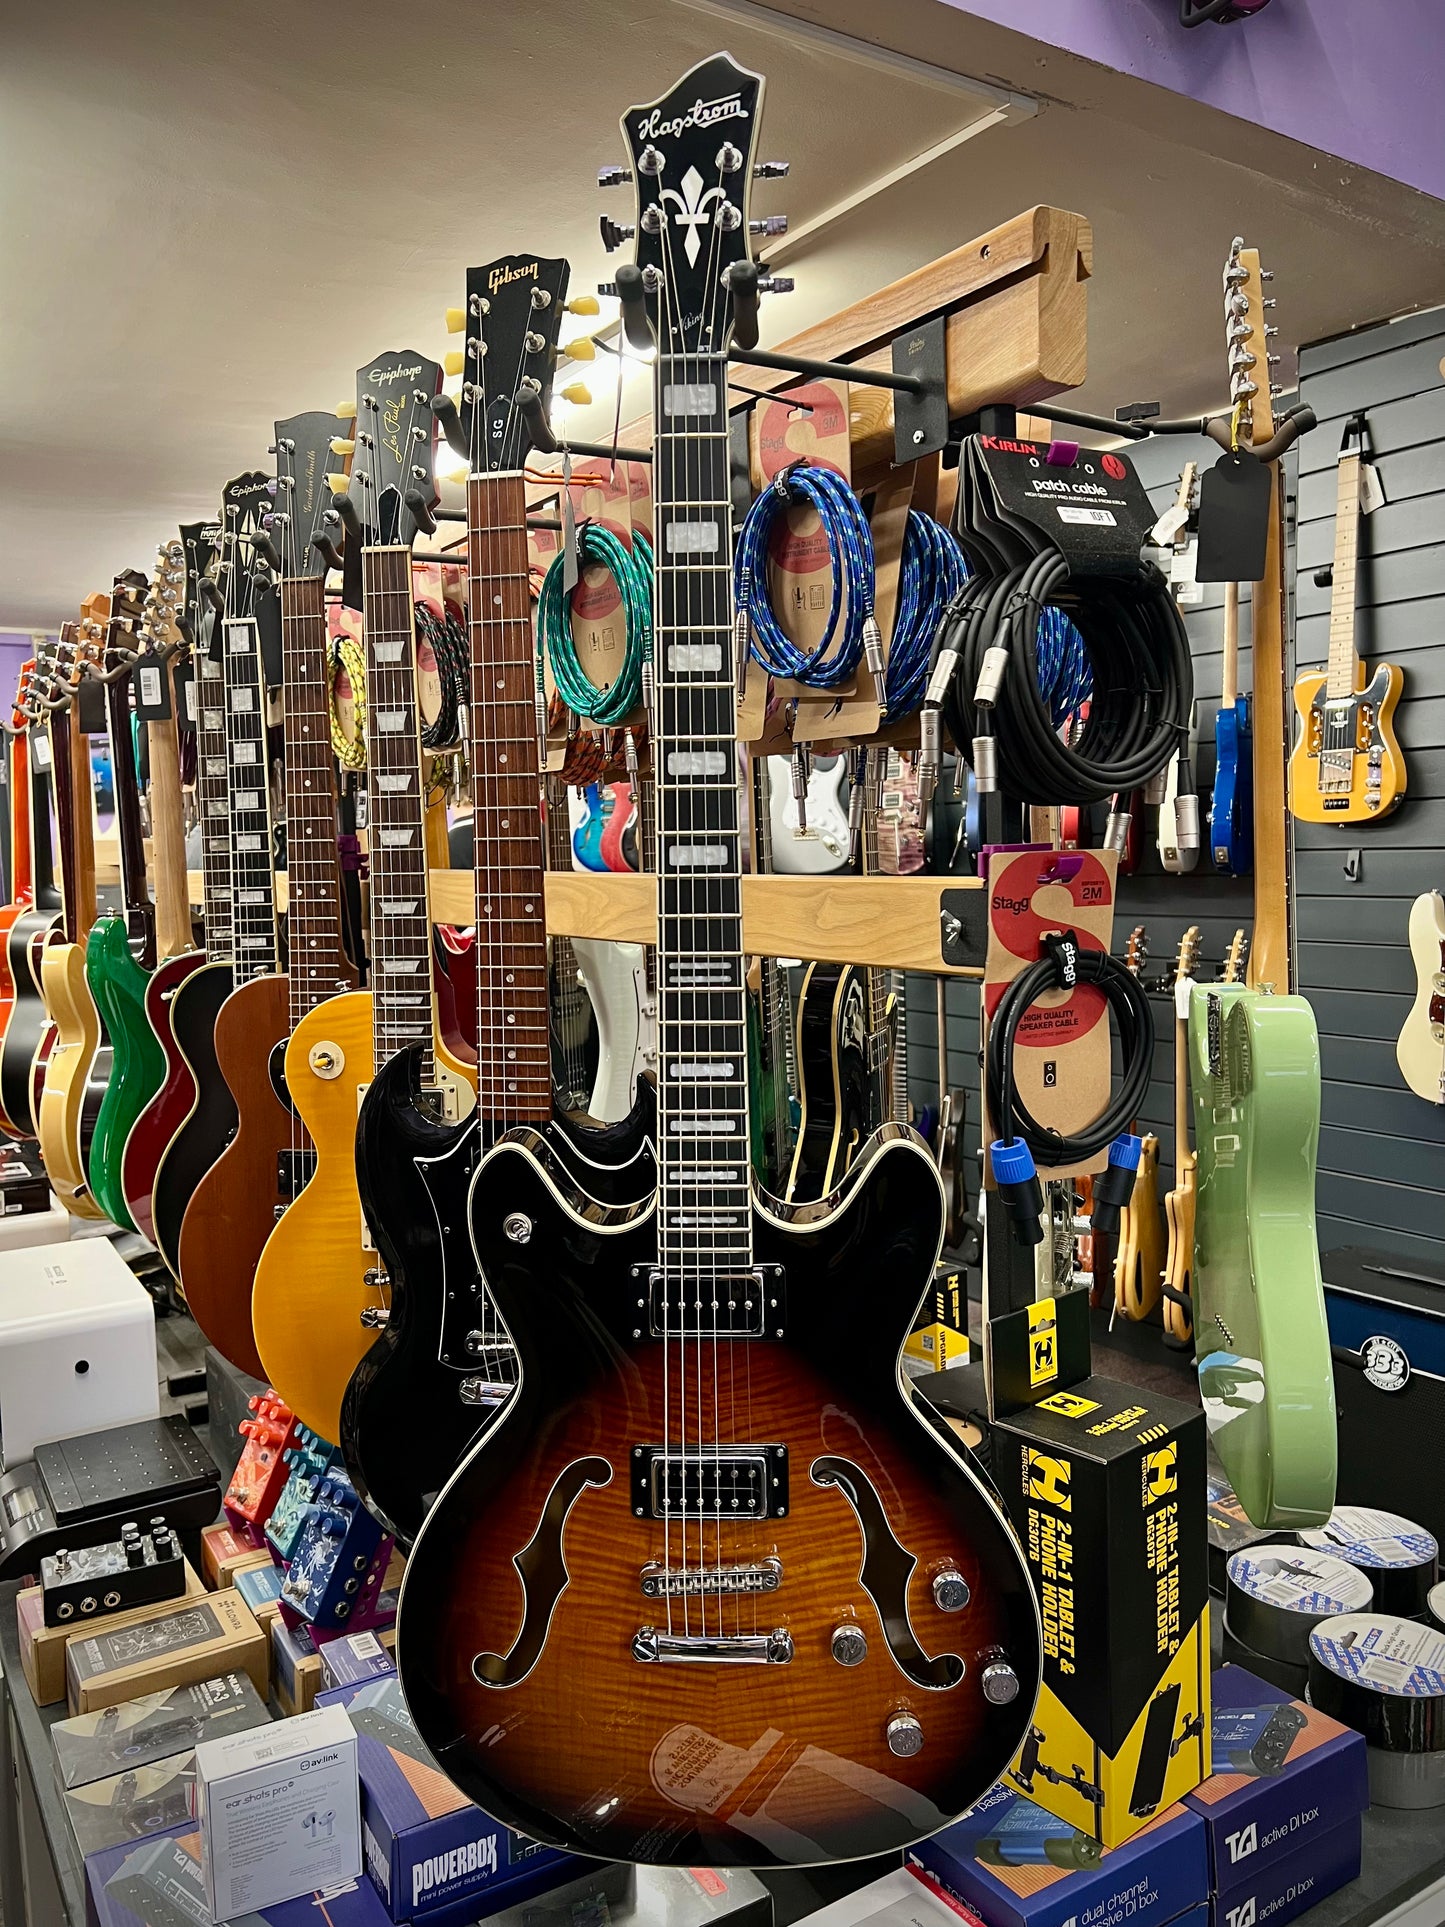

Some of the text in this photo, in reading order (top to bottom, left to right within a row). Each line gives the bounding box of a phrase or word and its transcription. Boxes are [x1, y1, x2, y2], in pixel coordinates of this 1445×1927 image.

[638, 93, 749, 139] Hagstrom
[488, 263, 539, 295] Gibson
[368, 364, 422, 387] Epiphone
[383, 400, 401, 434] Paul
[493, 419, 503, 438] SG
[384, 434, 402, 464] Les
[761, 436, 784, 452] Stagg
[981, 435, 1037, 454] KIRLIN
[230, 482, 268, 497] Epiphon
[1032, 480, 1108, 496] patch cable
[992, 896, 1029, 915] Stagg
[1082, 887, 1102, 900] 2M
[1062, 942, 1076, 983] Stagg
[1019, 1018, 1079, 1031] SPEAKER CABLE
[1024, 1010, 1074, 1022] HIGH QUALITY
[1366, 1350, 1404, 1375] 333
[1021, 1445, 1029, 1496] HERCULES
[1028, 1508, 1040, 1562] DG307B
[1147, 1514, 1155, 1569] DG307B
[1041, 1513, 1059, 1658] PHONE HOLDER
[1156, 1507, 1168, 1654] PHONE HOLDER
[1167, 1502, 1179, 1656] 2-IN-1 TABLET &
[1057, 1519, 1075, 1674] 2-IN-1 TABLET &
[227, 1674, 243, 1696] NUX
[225, 1799, 241, 1809] ear
[272, 1784, 288, 1799] pro
[1261, 1825, 1289, 1848] active
[1289, 1814, 1301, 1832] DI
[1301, 1807, 1320, 1825] box
[412, 1834, 497, 1907] POWERBOX
[420, 1870, 489, 1902] mini power supply
[1081, 1900, 1105, 1925] dual
[1107, 1876, 1149, 1911] channel
[1125, 1901, 1138, 1918] DI
[1139, 1889, 1159, 1912] box
[1259, 1896, 1286, 1920] active
[1286, 1885, 1297, 1902] DI
[1297, 1877, 1315, 1894] box
